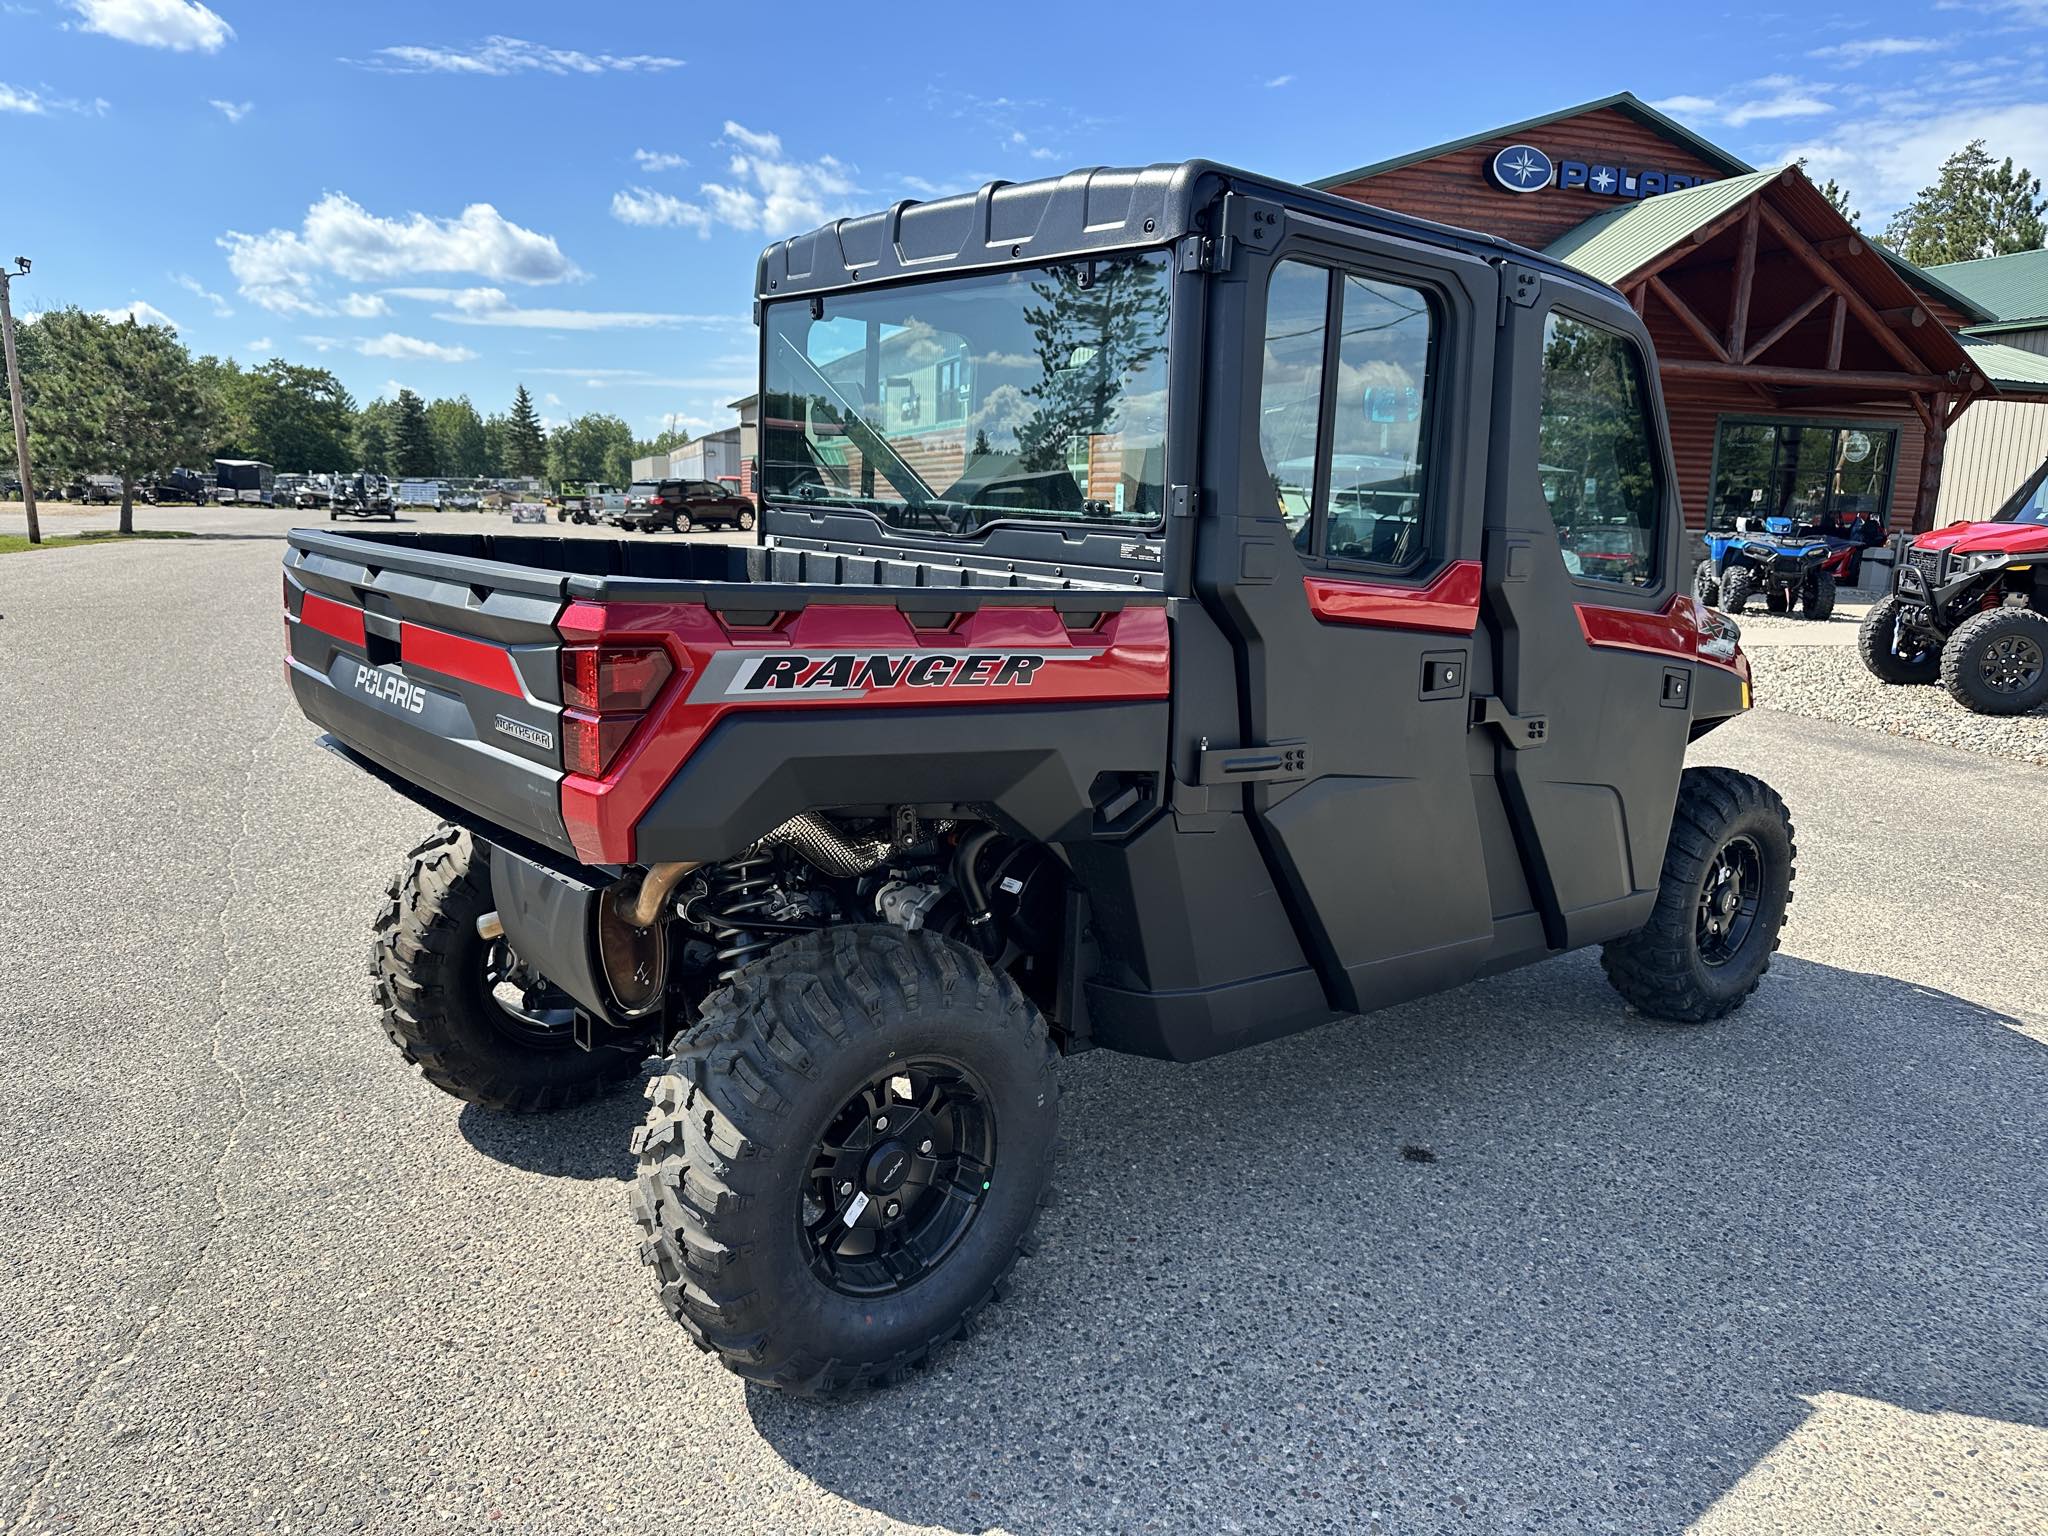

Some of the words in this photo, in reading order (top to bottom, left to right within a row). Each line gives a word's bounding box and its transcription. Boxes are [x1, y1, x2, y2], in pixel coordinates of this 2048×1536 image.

[354, 664, 426, 714] POLARIS
[743, 654, 1045, 691] RANGER
[496, 718, 550, 747] NORTHSTAR
